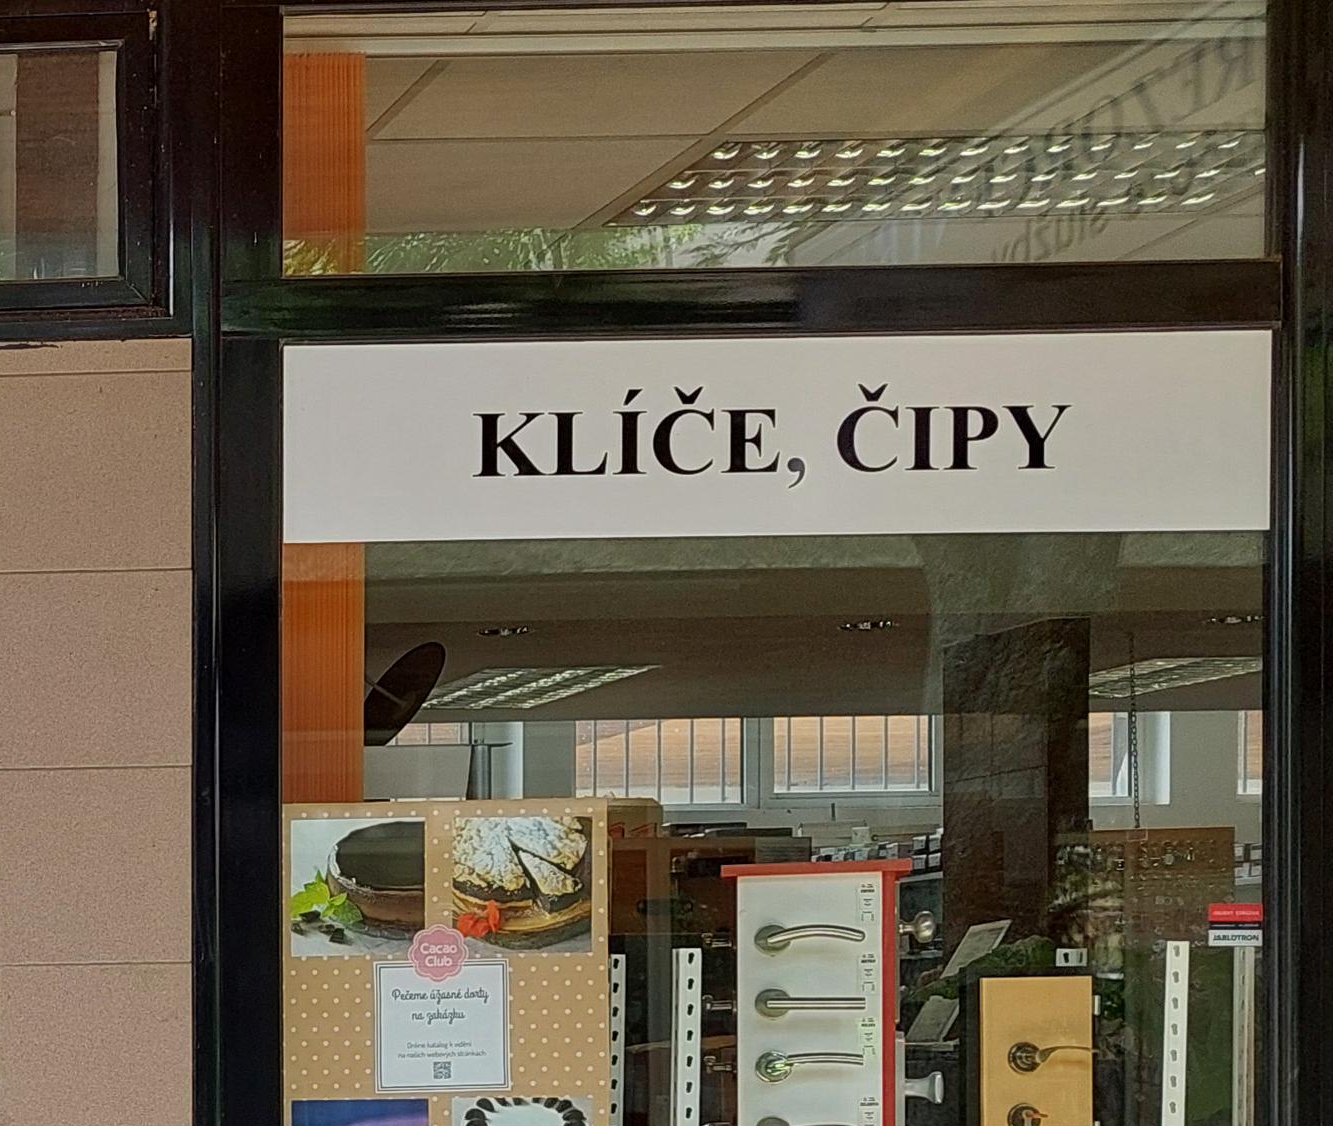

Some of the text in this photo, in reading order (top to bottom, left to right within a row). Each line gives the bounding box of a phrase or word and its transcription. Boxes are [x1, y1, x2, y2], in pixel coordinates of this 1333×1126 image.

[472, 382, 1072, 489] KLÍČE, ČIPY
[420, 943, 458, 954] Cacao
[425, 955, 453, 967] Club
[392, 989, 428, 1001] Pečeme
[464, 987, 489, 1004] dorty
[412, 1008, 466, 1025] na zakázku
